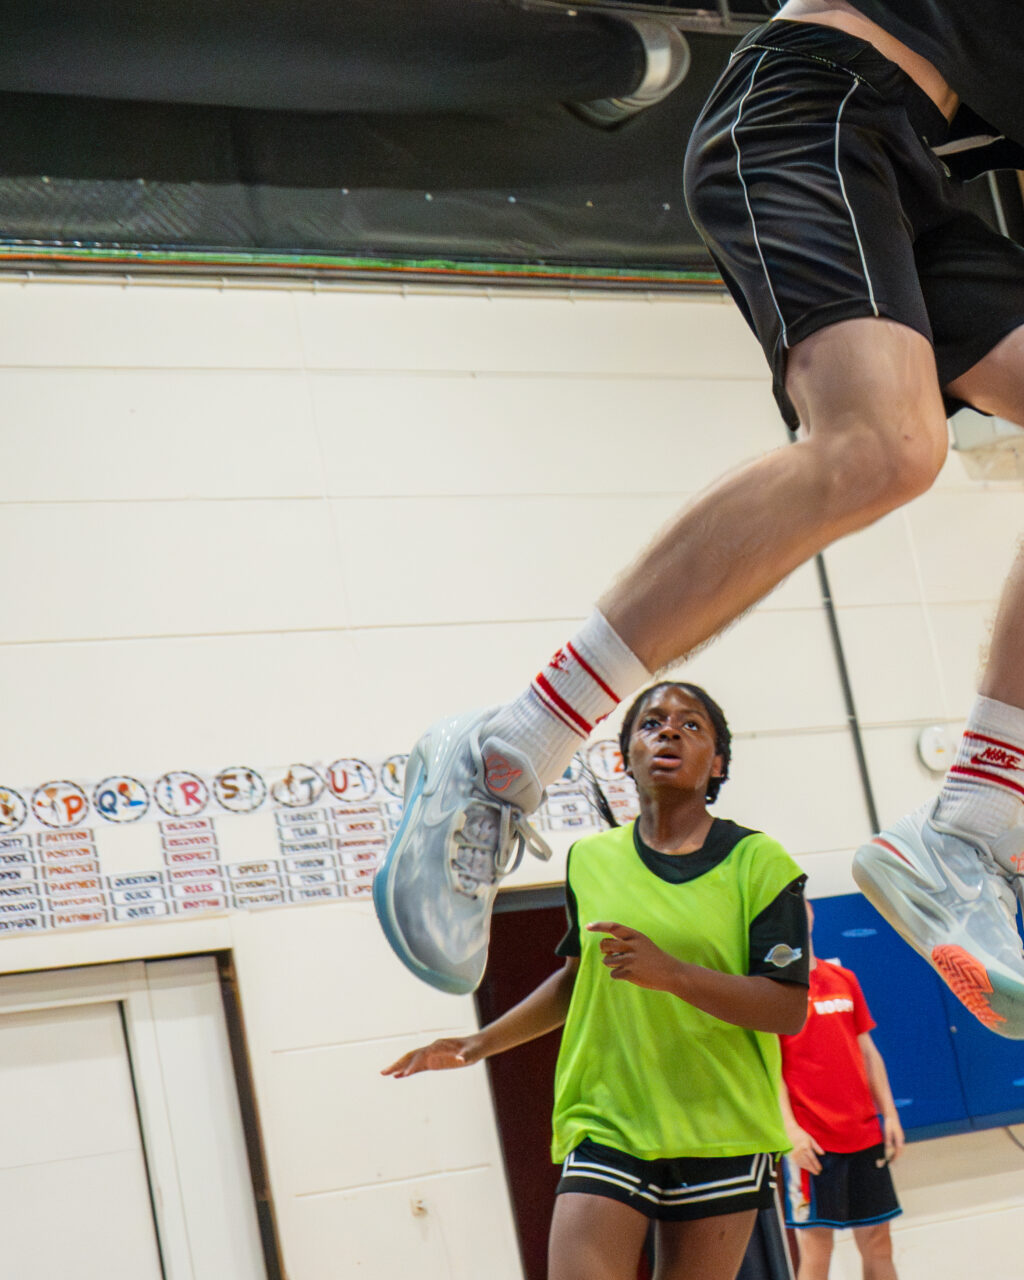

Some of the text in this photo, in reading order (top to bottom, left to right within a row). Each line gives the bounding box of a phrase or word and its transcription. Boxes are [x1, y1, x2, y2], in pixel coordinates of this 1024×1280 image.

[980, 746, 1021, 765] NIKE
[220, 774, 239, 799] S
[331, 769, 348, 793] U
[179, 781, 202, 806] R
[301, 777, 316, 804] T
[100, 790, 118, 814] Q
[62, 795, 84, 822] P
[45, 831, 88, 842] PATTERN
[292, 827, 318, 836] TEAM
[46, 847, 91, 858] POSITION
[171, 851, 212, 862] RESPECT
[47, 863, 94, 875] PRACTICE
[49, 879, 97, 891] PARTNER
[115, 875, 157, 887] QUESTION
[182, 882, 213, 894] RULES
[126, 905, 156, 918] QUIET
